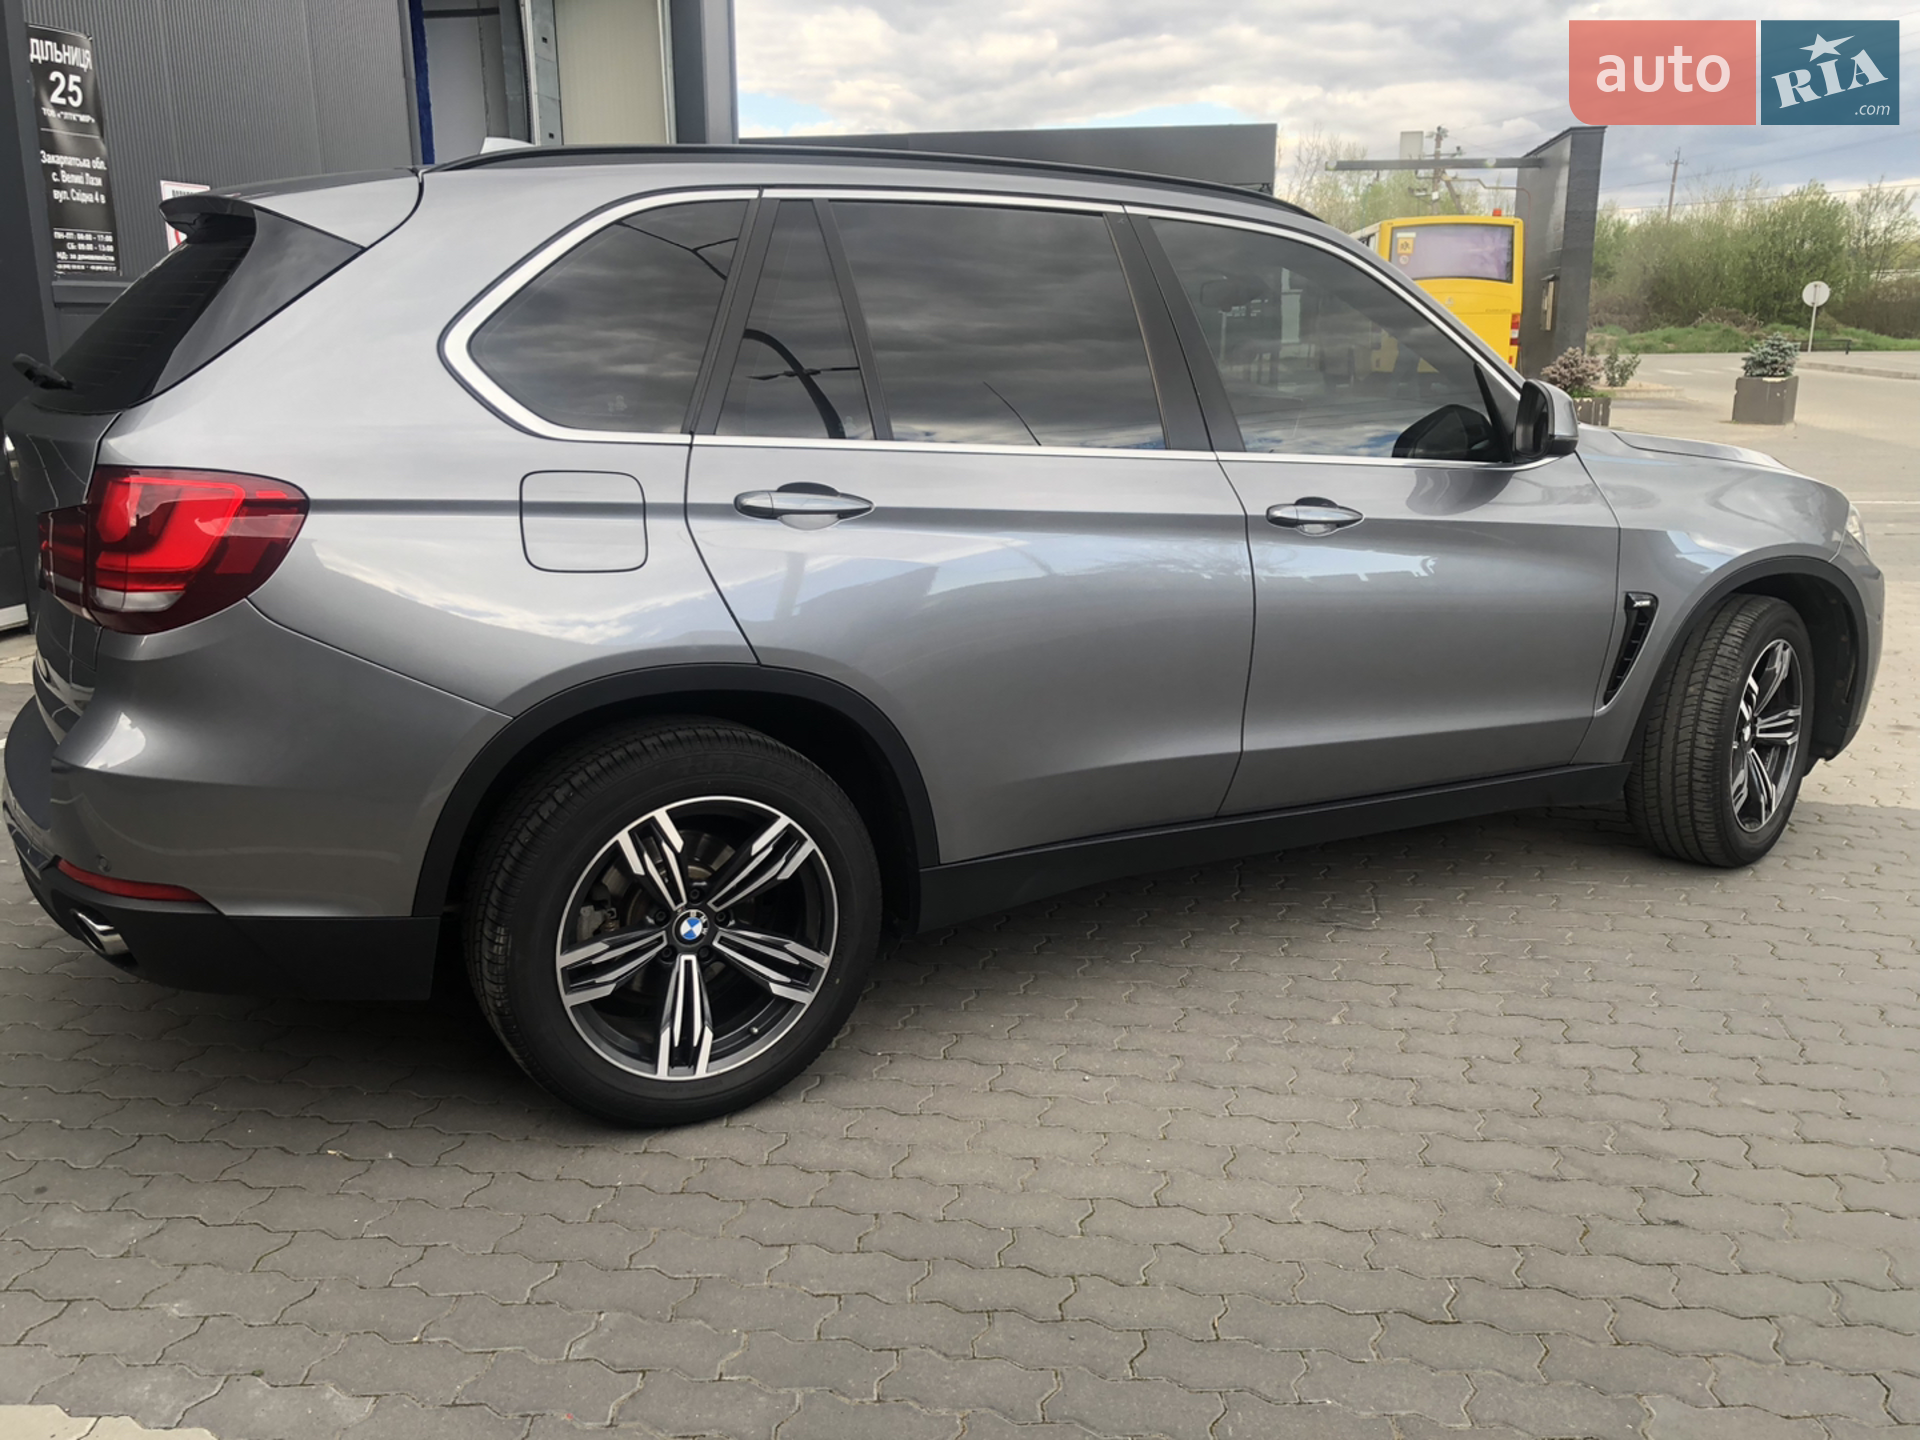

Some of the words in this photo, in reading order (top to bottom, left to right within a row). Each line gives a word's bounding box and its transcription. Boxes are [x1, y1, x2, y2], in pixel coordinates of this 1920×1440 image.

[30, 38, 92, 72] ДІЛЬНИЦЯ
[49, 71, 83, 107] 25
[40, 150, 91, 168] Закарпатська
[92, 157, 107, 170] обл.
[53, 189, 70, 203] вул.
